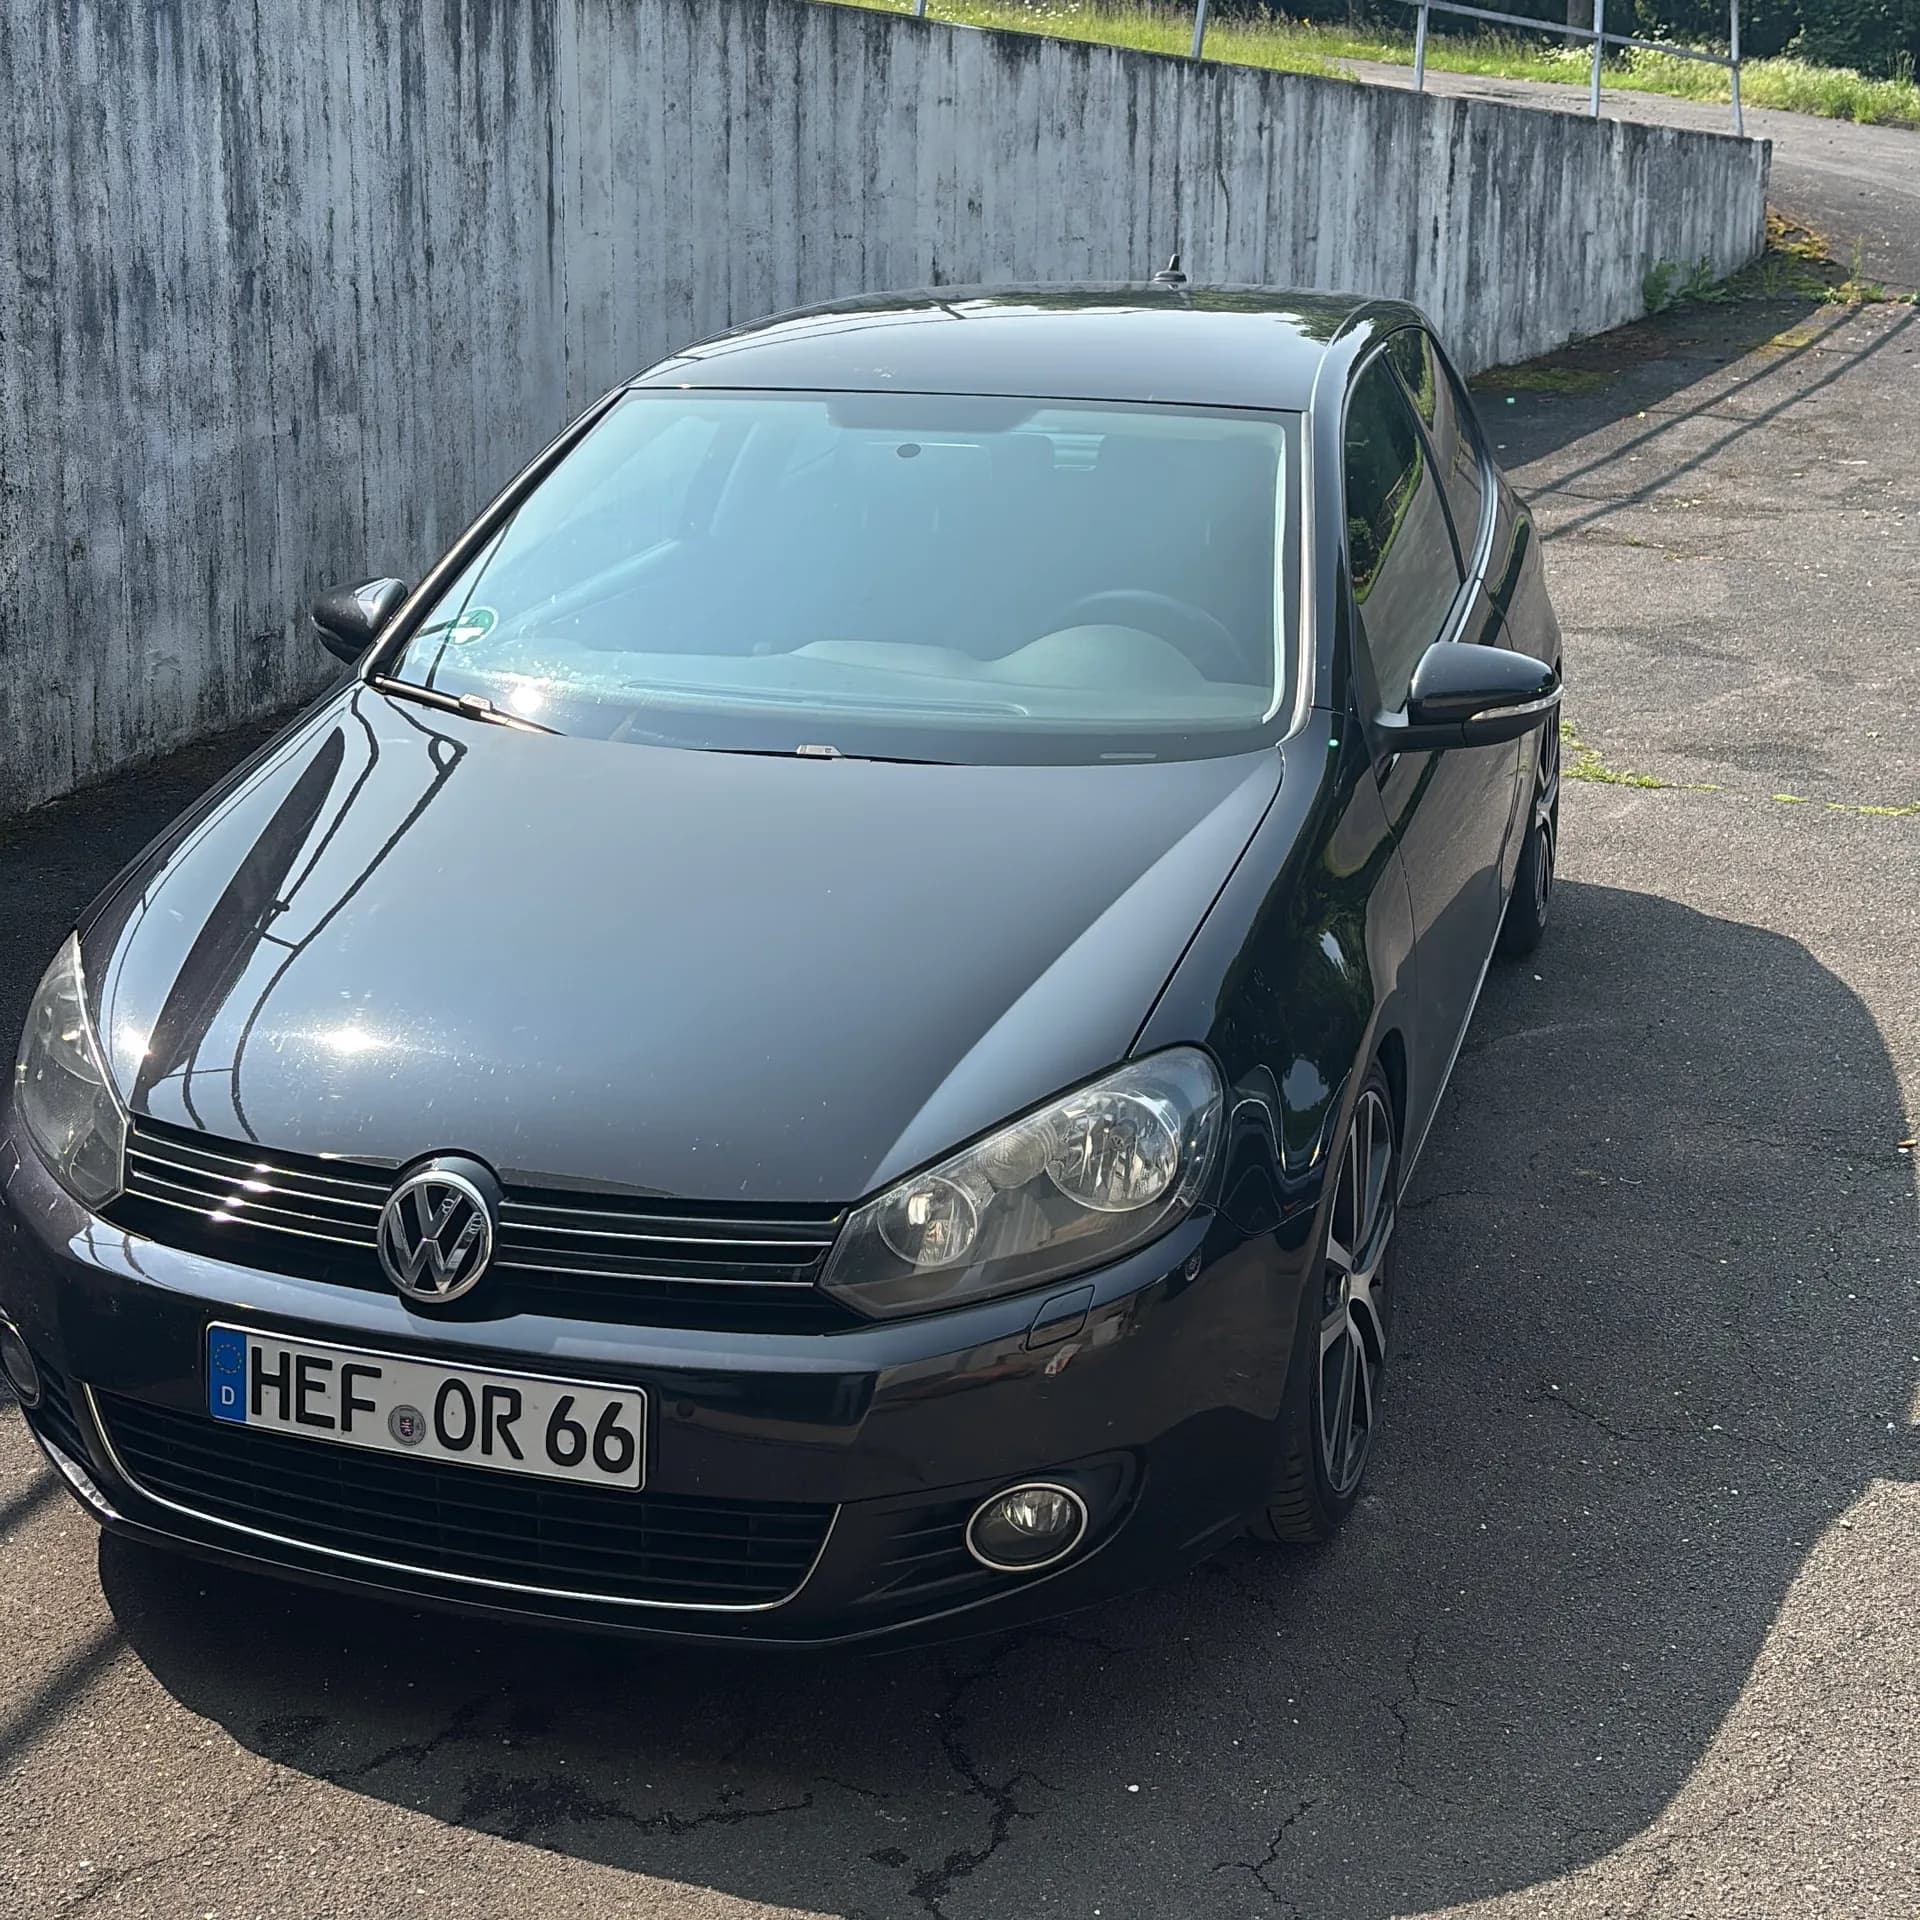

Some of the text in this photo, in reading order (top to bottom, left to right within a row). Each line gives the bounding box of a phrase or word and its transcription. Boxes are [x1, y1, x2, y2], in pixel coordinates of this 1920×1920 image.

[386, 1181, 485, 1296] VW
[221, 1385, 235, 1405] D
[250, 1346, 635, 1473] HEF OR 66
